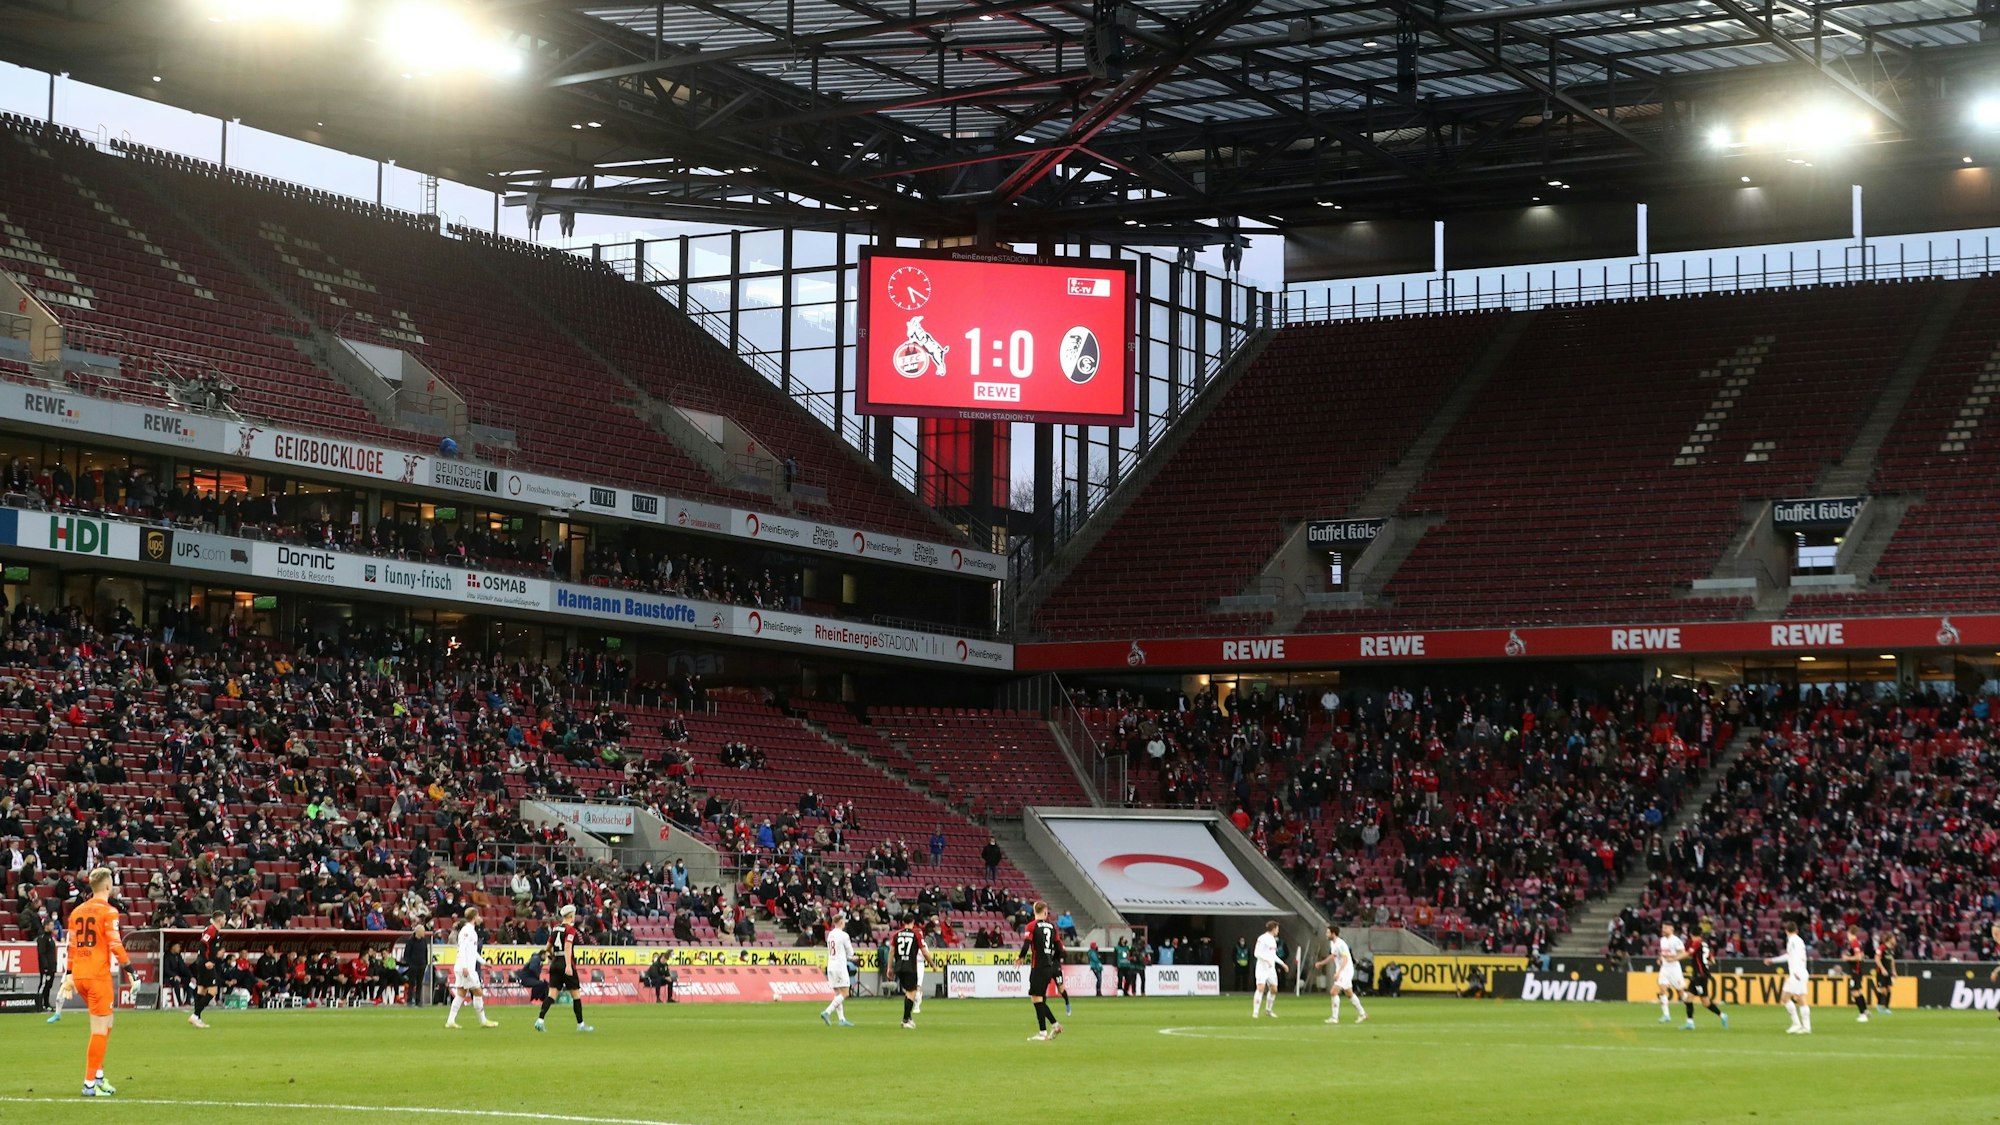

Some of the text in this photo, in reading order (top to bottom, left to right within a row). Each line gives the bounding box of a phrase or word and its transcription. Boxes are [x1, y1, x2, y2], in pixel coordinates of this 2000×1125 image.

[964, 327, 1034, 379] 1:0
[977, 386, 1017, 398] REWE
[25, 393, 66, 416] REWE
[143, 413, 182, 436] REWE
[959, 411, 1034, 421] TELEKOM STADION-TV
[275, 434, 384, 474] GEIßBOCKLOGE
[435, 461, 482, 479] DEUTSCHE
[435, 473, 482, 491] STEINZEUG
[526, 484, 550, 496] Flossbach
[551, 489, 561, 497] von
[592, 489, 615, 506] UTH
[634, 496, 657, 513] UTH
[1774, 503, 1818, 522] Gaffel
[49, 515, 110, 556] HDI
[760, 522, 800, 539] RheinEnergie
[815, 525, 835, 538] Rhein
[1308, 523, 1346, 542] Gaffel
[812, 534, 839, 549] Energie
[866, 540, 902, 556] RheinEnergie
[916, 543, 935, 556] Rhein
[177, 541, 226, 562] UPS.com
[278, 546, 335, 571] Dorint
[914, 552, 938, 566] Energie
[963, 556, 997, 572] RheinEnergie
[277, 566, 335, 584] Hotels & Resorts
[385, 564, 452, 591] funny-frisch
[483, 576, 527, 595] OSMAB
[557, 588, 622, 615] Hamann
[624, 597, 696, 624] Baustoffe
[763, 620, 803, 635] RheinEnergie
[1771, 623, 1845, 646] REWE
[815, 624, 918, 653] RheinEnergieSTADION
[1360, 635, 1425, 657] REWE
[1611, 627, 1682, 650] REWE
[968, 648, 1003, 662] RheinEnergie
[1223, 639, 1285, 661] REWE
[592, 812, 625, 826] Rosbacher
[75, 916, 97, 948] 26
[554, 931, 562, 951] 4
[1043, 927, 1052, 949] 3
[125, 939, 151, 951] REWE
[897, 937, 914, 956] 27
[497, 950, 524, 965] Köln
[600, 950, 625, 965] Köln
[784, 952, 807, 966] Köln
[946, 953, 966, 965] Köln
[1521, 970, 1598, 1001] bwin
